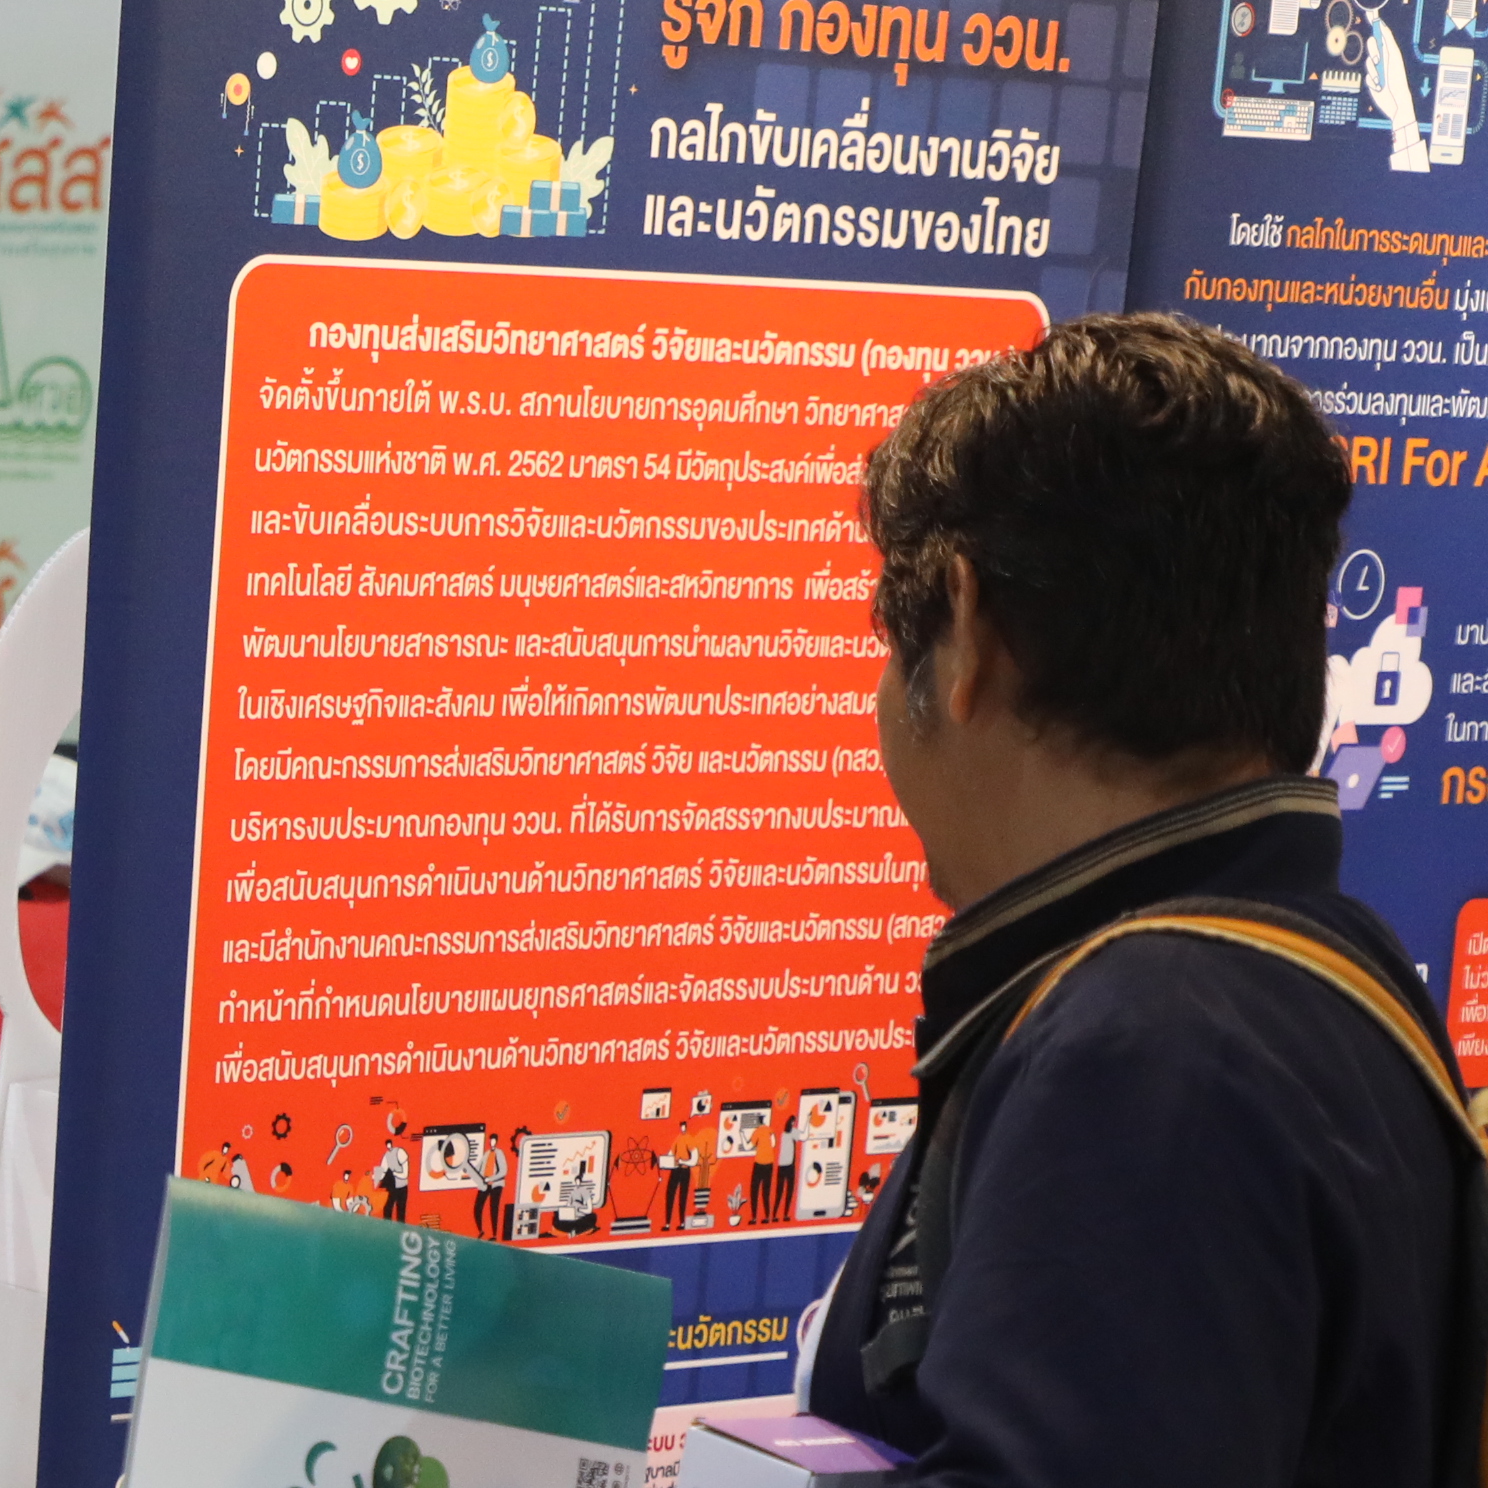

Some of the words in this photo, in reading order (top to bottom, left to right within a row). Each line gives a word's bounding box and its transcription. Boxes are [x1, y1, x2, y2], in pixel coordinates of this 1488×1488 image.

[962, 12, 1072, 74] ววน.
[649, 96, 1061, 185] กลไกขับเคลื่อนงานวิจัย
[642, 184, 1052, 259] และนวัตกรรมของไทย
[1229, 213, 1284, 248] โดยใช้
[1184, 268, 1450, 312] กับกองทุนและหน่วยงานอื่น
[309, 313, 648, 363] กองทุนส่งเสริมวิทยาศาสตร์
[651, 326, 856, 369] วิจัยและนวัตกรรม
[861, 338, 950, 383] (กองทุน
[1402, 338, 1447, 366] ววน.
[258, 367, 433, 414] จัดตั้งขึ้นภายใต้
[438, 389, 512, 416] พ.ร.บ.
[519, 385, 799, 431] สภานโยบายการอุดมศึกษา
[255, 440, 447, 475] นวัตกรรมแห่งชาติ
[452, 450, 502, 477] พ.ศ.
[507, 450, 564, 478] 2562
[568, 453, 639, 481] มาตรา
[643, 453, 671, 481] 54
[1400, 436, 1469, 487] For
[246, 562, 353, 597] เทคโนโลยี
[357, 564, 496, 598] สังคมศาสตร์
[499, 566, 794, 607] มนุษยศาสตร์และสหวิทยาการ
[242, 624, 509, 658] พัฒนานโยบายสาธารณะ
[237, 685, 495, 726] ในเชิงเศรษฐกิจและสังคม
[234, 742, 648, 781] โดยมีคณะกรรมการส่งเสริมวิทยาศาสตร์
[651, 743, 693, 774] วิจัย
[697, 743, 828, 774] และนวัตกรรม
[230, 806, 506, 846] บริหารงบประมาณกองทุน
[511, 811, 563, 836] ววน.
[226, 857, 704, 910] เพื่อสนับสนุนการดำเนินงานด้านวิทยาศาสตร์
[222, 913, 716, 964] และมีสำนักงานคณะกรรมการส่งเสริมวิทยาศาสตร์
[719, 912, 883, 945] วิจัยและนวัตกรรม
[218, 964, 899, 1025] ทำหน้าที่กำหนดนโยบายแผนยุทธศาสตร์และจัดสรรงบประมาณด้าน
[214, 1029, 672, 1089] เพื่อสนับสนุนการดำเนินงานด้านวิทยาศาสตร์
[443, 1238, 458, 1290] LIVING
[380, 1230, 424, 1396] CRAFTING
[405, 1234, 442, 1401] BIOTECHNOLOGY
[434, 1293, 455, 1353] BETTER
[424, 1371, 440, 1404] FOR
[431, 1355, 444, 1369] A
